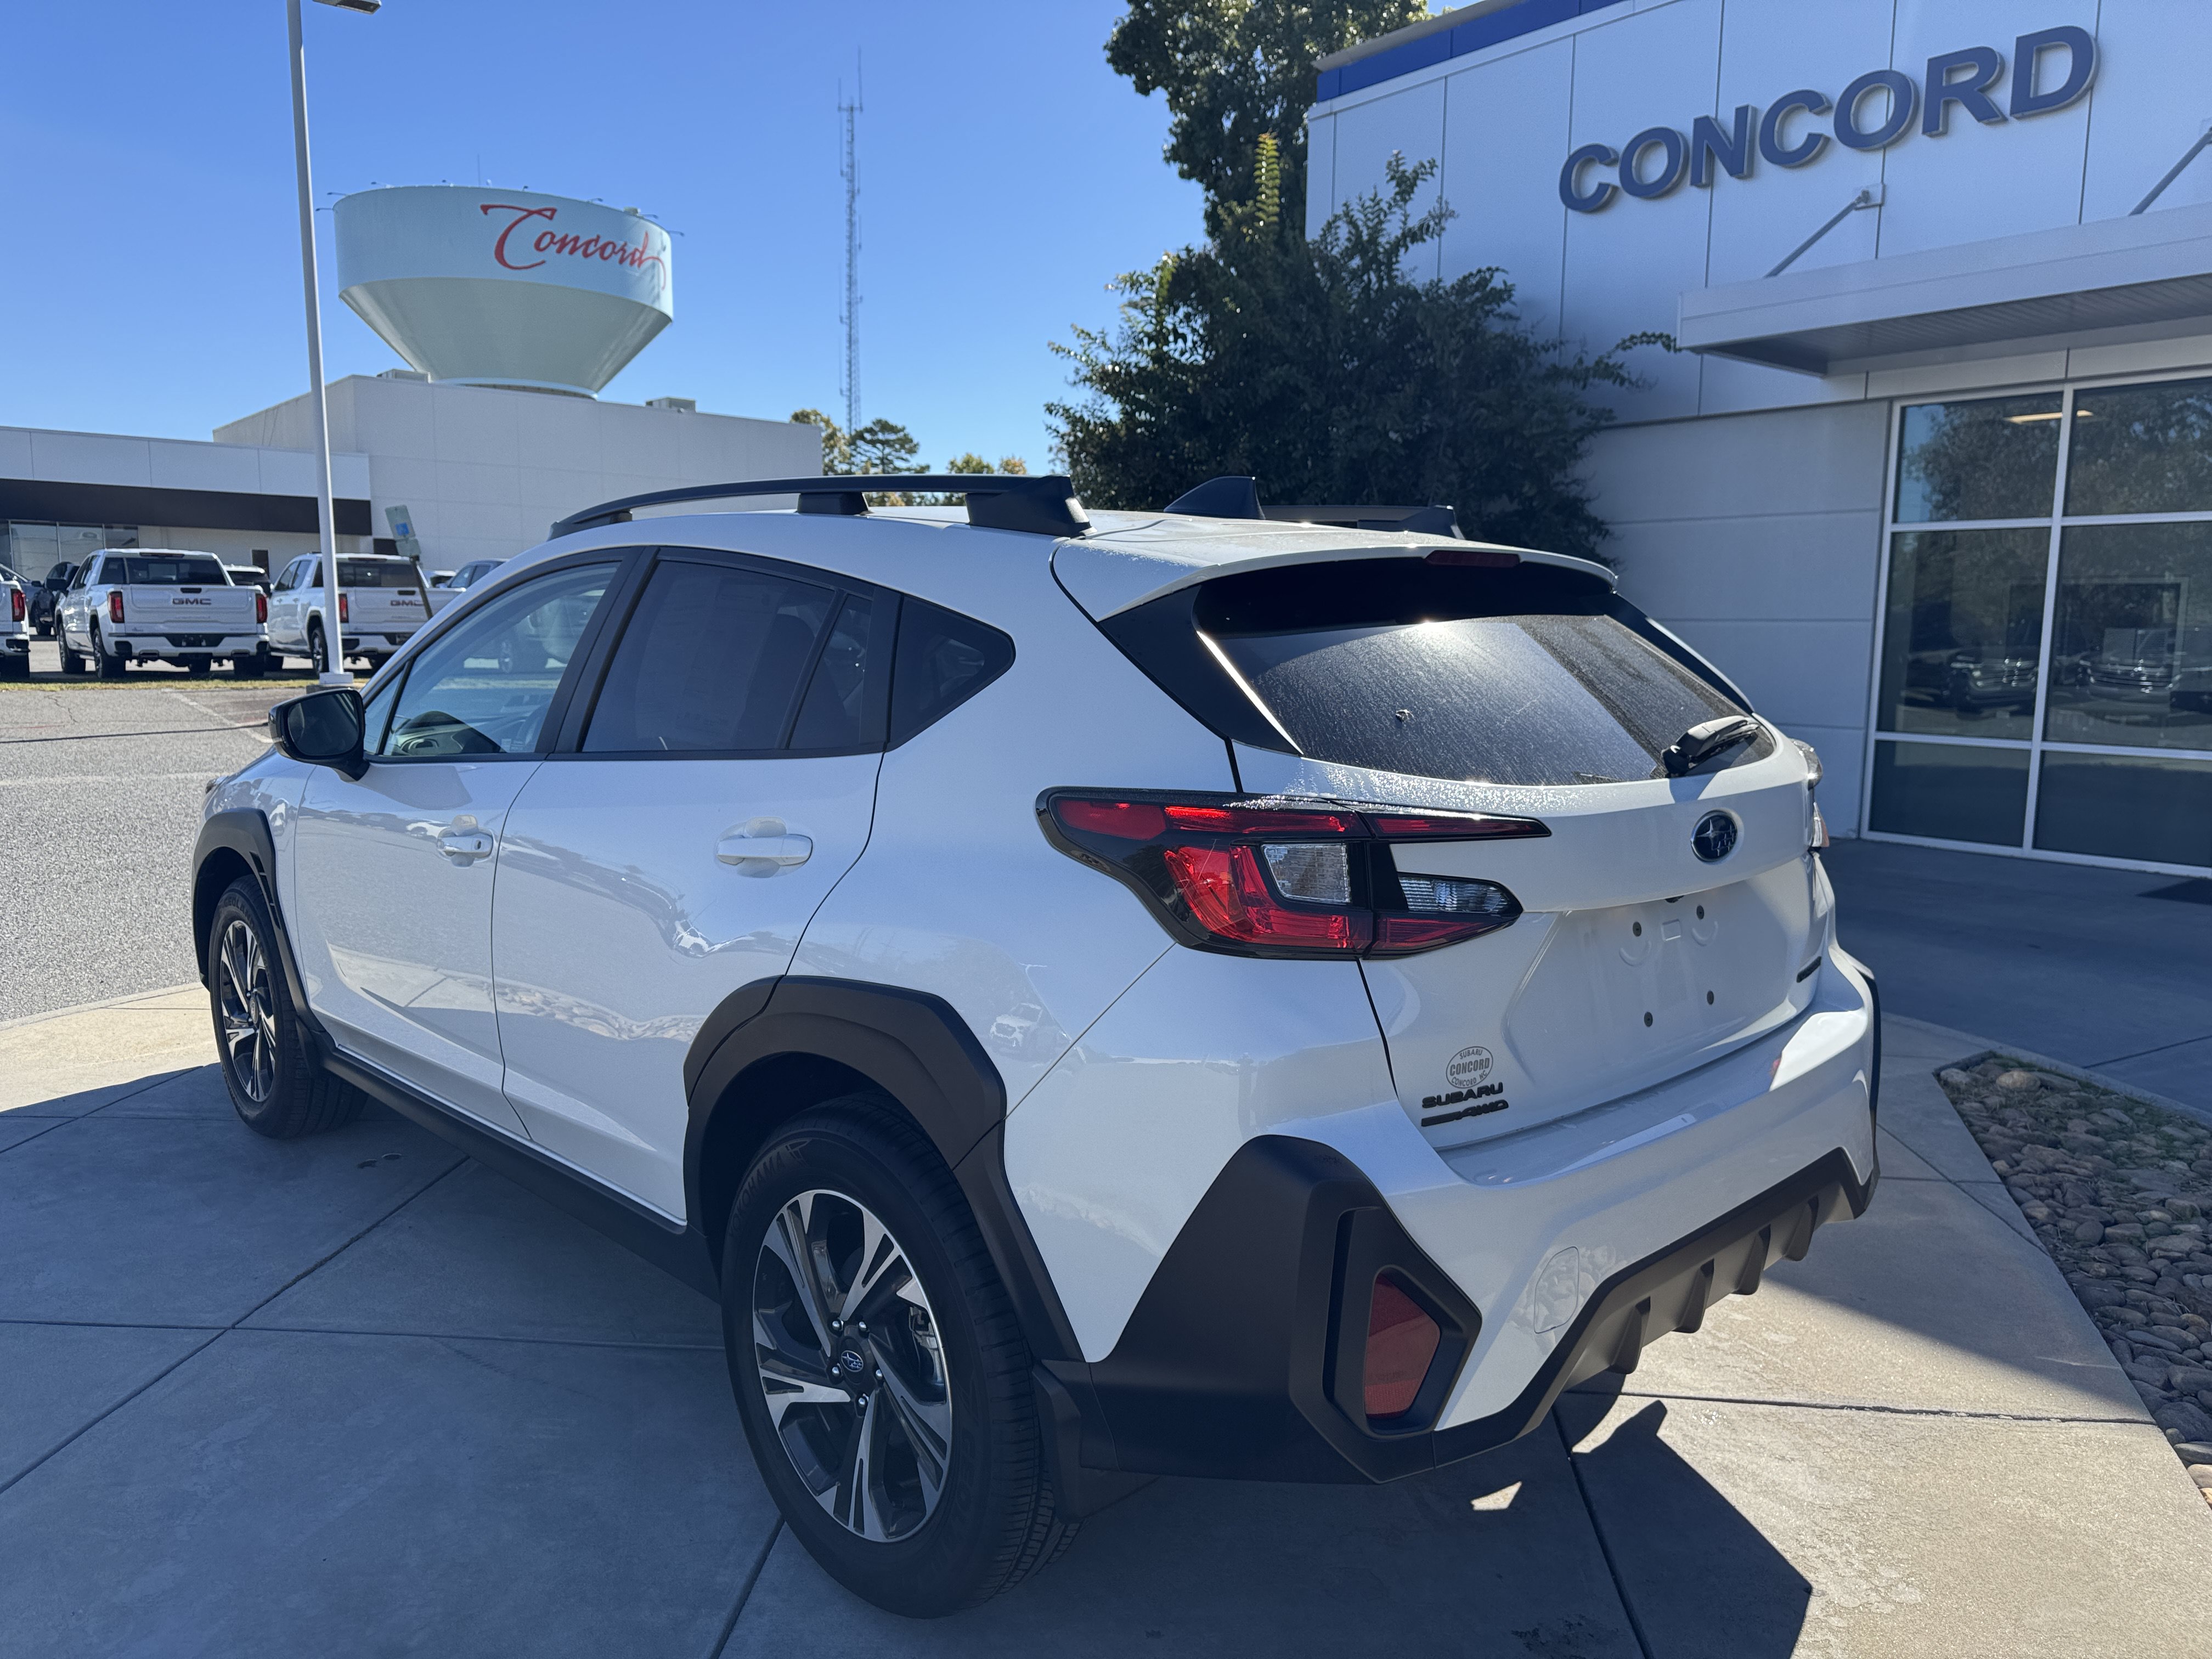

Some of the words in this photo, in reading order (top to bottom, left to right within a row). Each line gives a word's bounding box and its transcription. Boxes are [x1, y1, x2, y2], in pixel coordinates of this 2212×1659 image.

[1559, 25, 2099, 213] CONCORD
[479, 204, 667, 291] Concord
[1459, 1048, 1483, 1059] SUBARU
[1449, 1057, 1490, 1077] CONCORD
[1451, 1076, 1477, 1087] CONCORD
[1422, 1082, 1503, 1108] SUBARU
